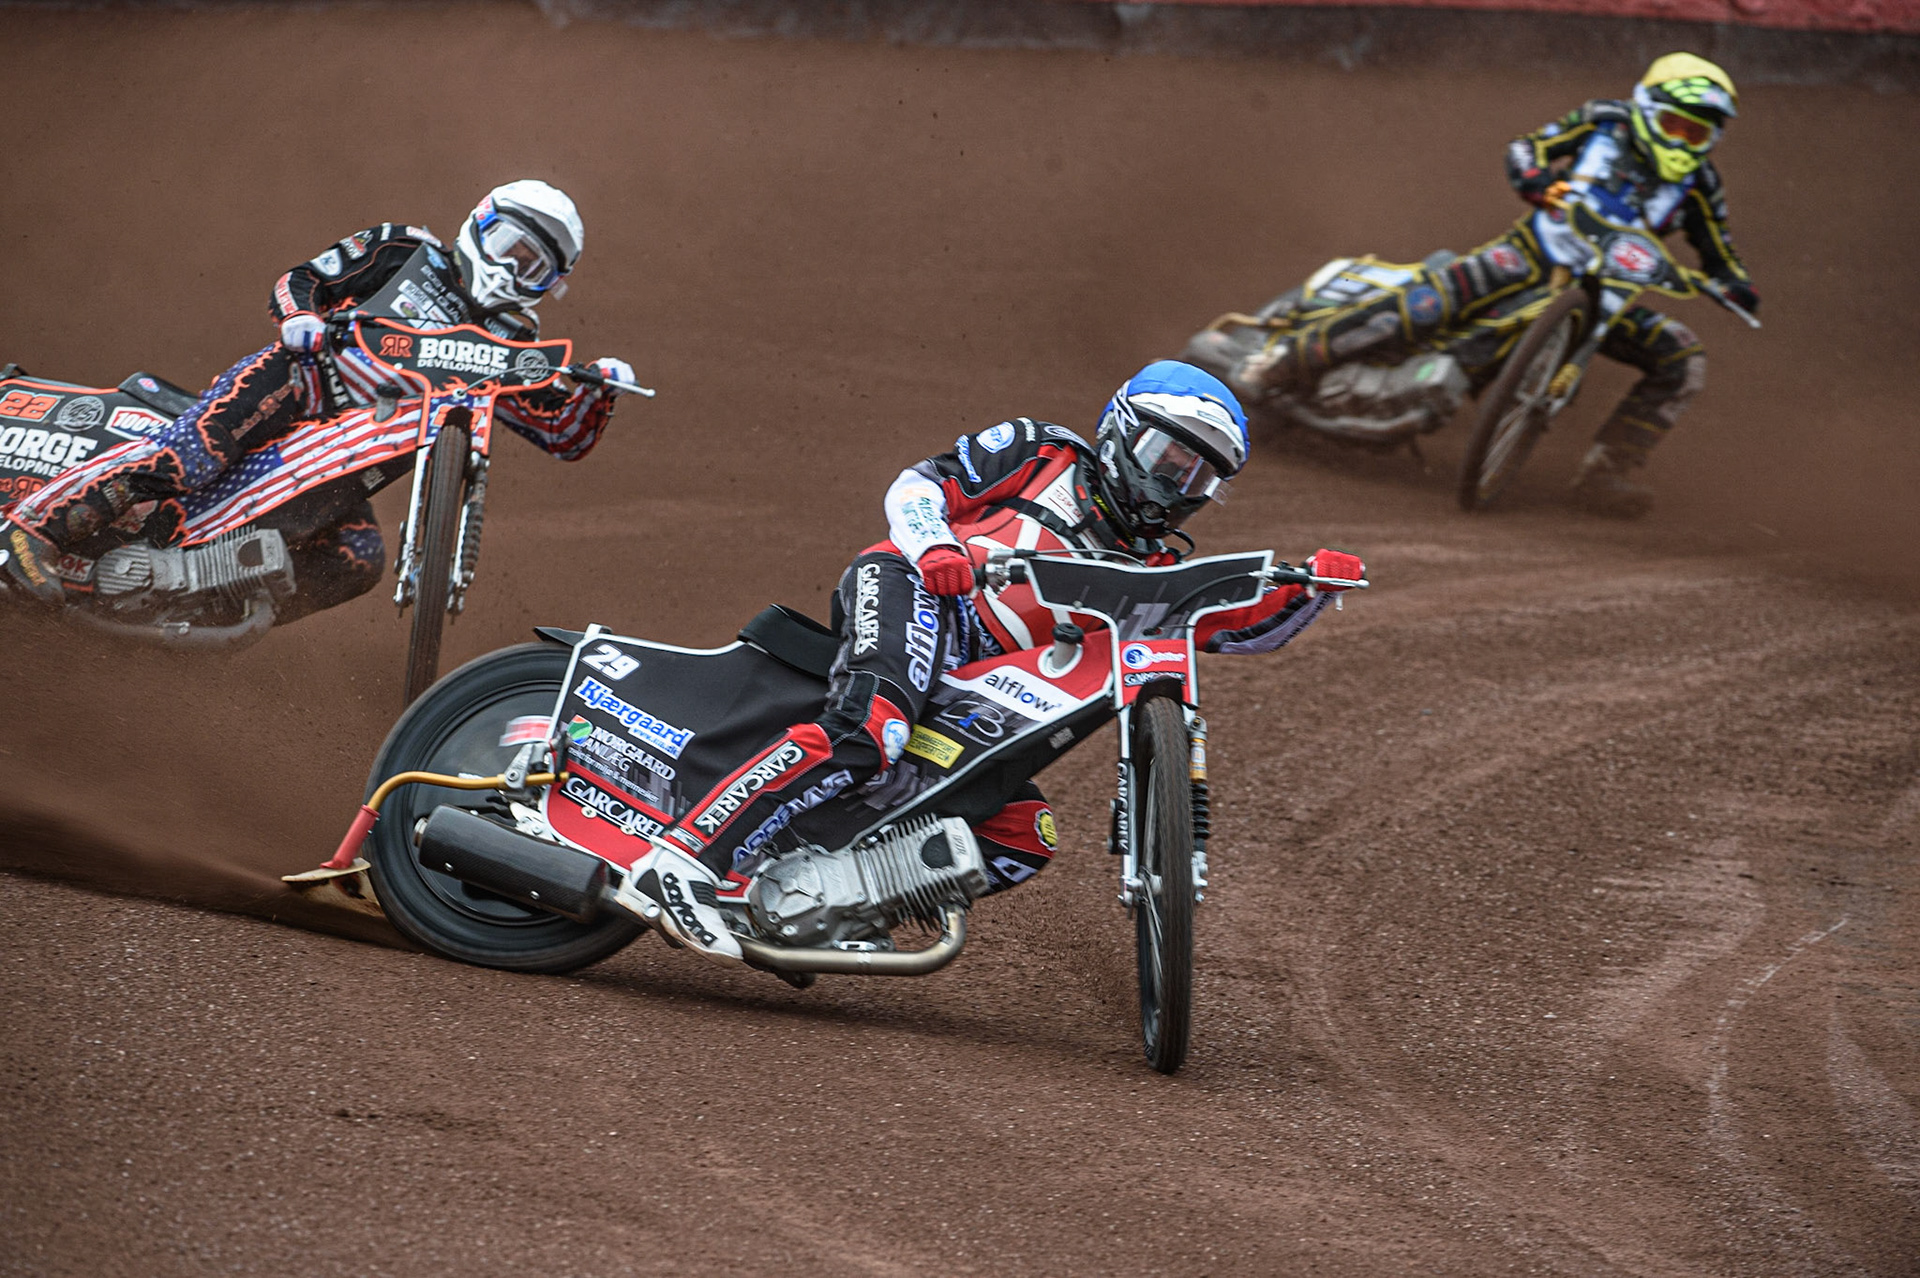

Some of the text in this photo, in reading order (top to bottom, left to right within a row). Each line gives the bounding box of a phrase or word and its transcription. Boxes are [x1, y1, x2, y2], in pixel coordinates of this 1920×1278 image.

[418, 337, 510, 370] BORGE
[0, 391, 59, 418] 22
[115, 411, 165, 435] 100%
[0, 424, 98, 467] ORGE
[857, 563, 881, 654] GARCAREK
[905, 577, 941, 692] alflow
[580, 643, 642, 681] 29
[580, 680, 689, 747] Kjærgaard
[984, 673, 1050, 712] alflow
[590, 726, 676, 781] NORGAARD
[694, 741, 803, 834] GARCAREK
